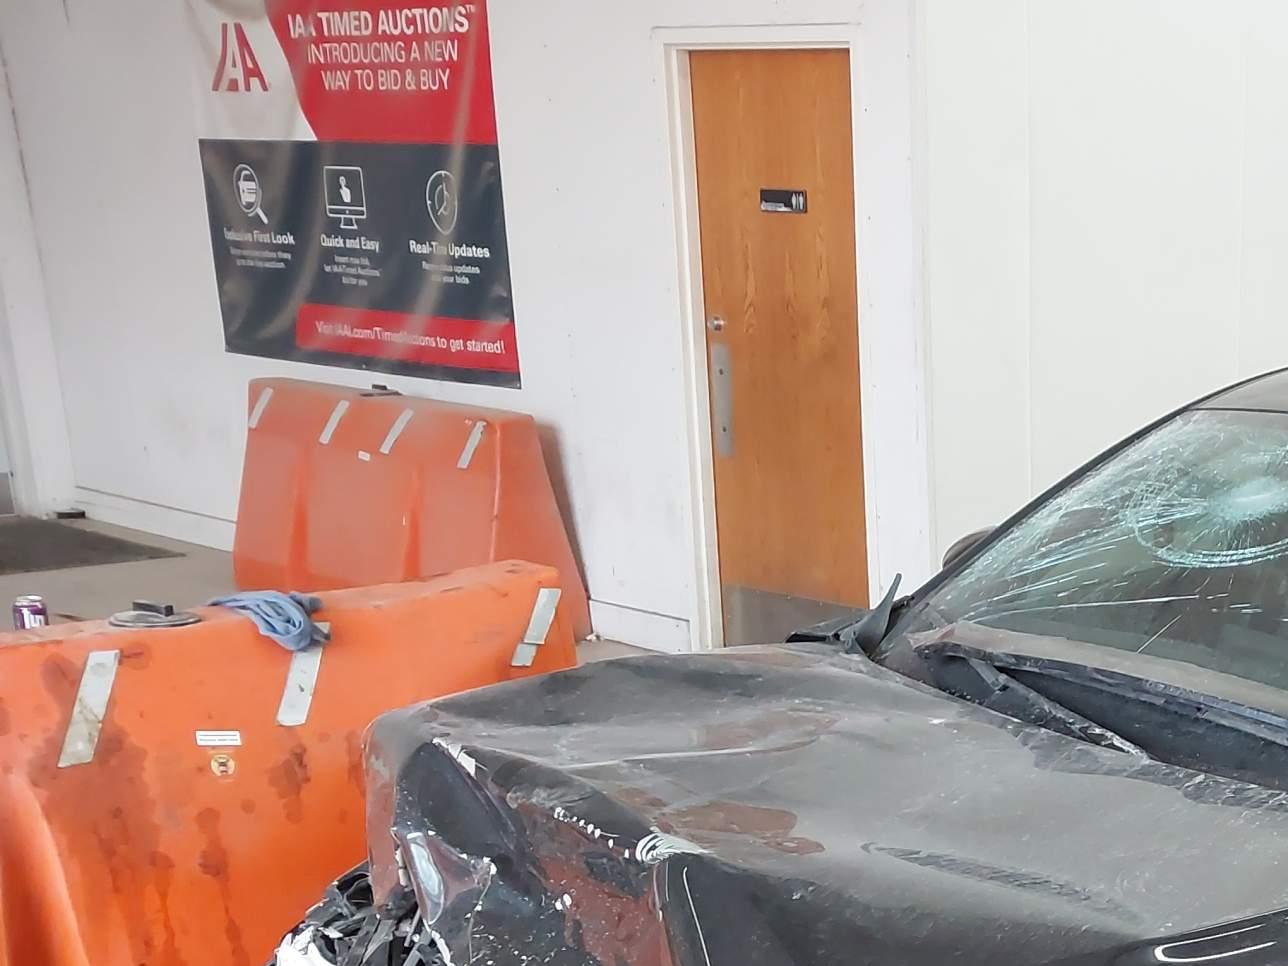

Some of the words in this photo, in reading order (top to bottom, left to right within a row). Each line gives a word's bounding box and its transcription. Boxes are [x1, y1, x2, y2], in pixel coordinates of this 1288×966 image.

[317, 10, 372, 37] TIMED
[308, 42, 405, 64] INTRODUCING
[410, 41, 420, 64] A
[424, 40, 458, 63] NEW
[321, 70, 351, 91] WAY
[354, 70, 374, 91] TO
[378, 69, 400, 90] BID
[405, 69, 416, 91] &
[421, 69, 450, 91] BUY
[271, 231, 295, 245] Look
[320, 233, 344, 248] Quick
[345, 236, 360, 248] and
[361, 236, 379, 253] Easy
[448, 242, 490, 258] Updates
[437, 336, 447, 348] to
[450, 338, 464, 352] get
[466, 339, 505, 354] started!
